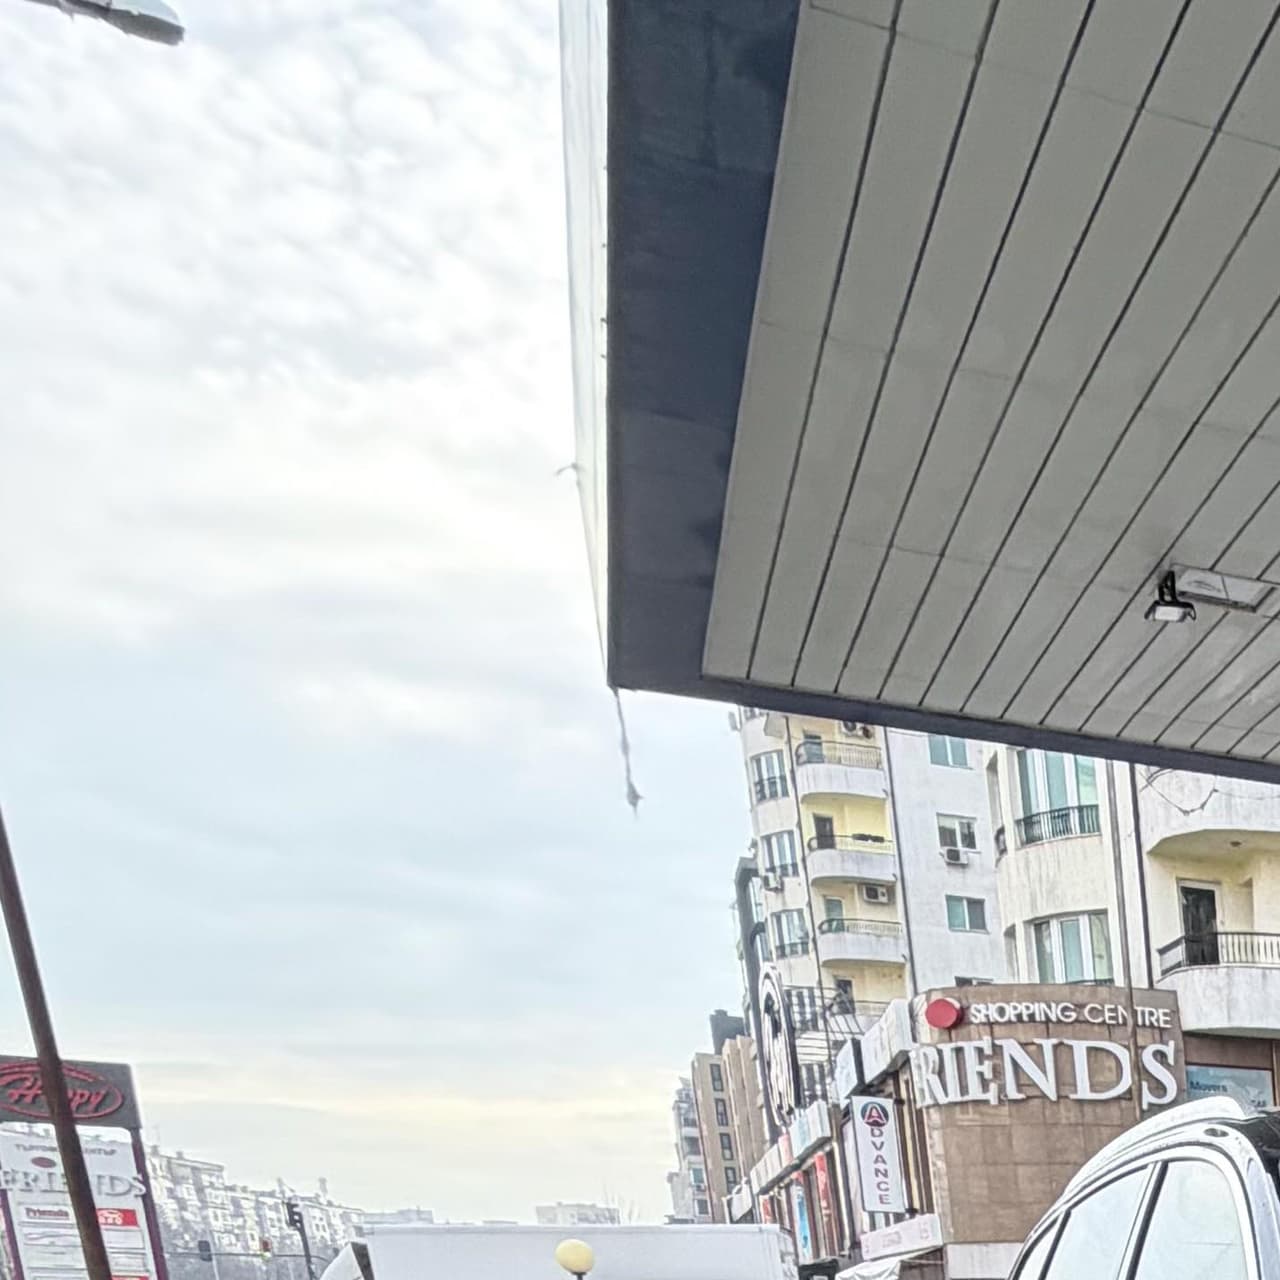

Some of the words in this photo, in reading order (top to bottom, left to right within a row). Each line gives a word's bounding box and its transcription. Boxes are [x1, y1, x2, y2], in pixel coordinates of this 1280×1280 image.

[970, 1002, 1077, 1024] SHOPPING
[1084, 1004, 1172, 1028] CENTRE
[909, 1036, 1178, 1110] RIENDS
[860, 1101, 892, 1205] ADVANCE
